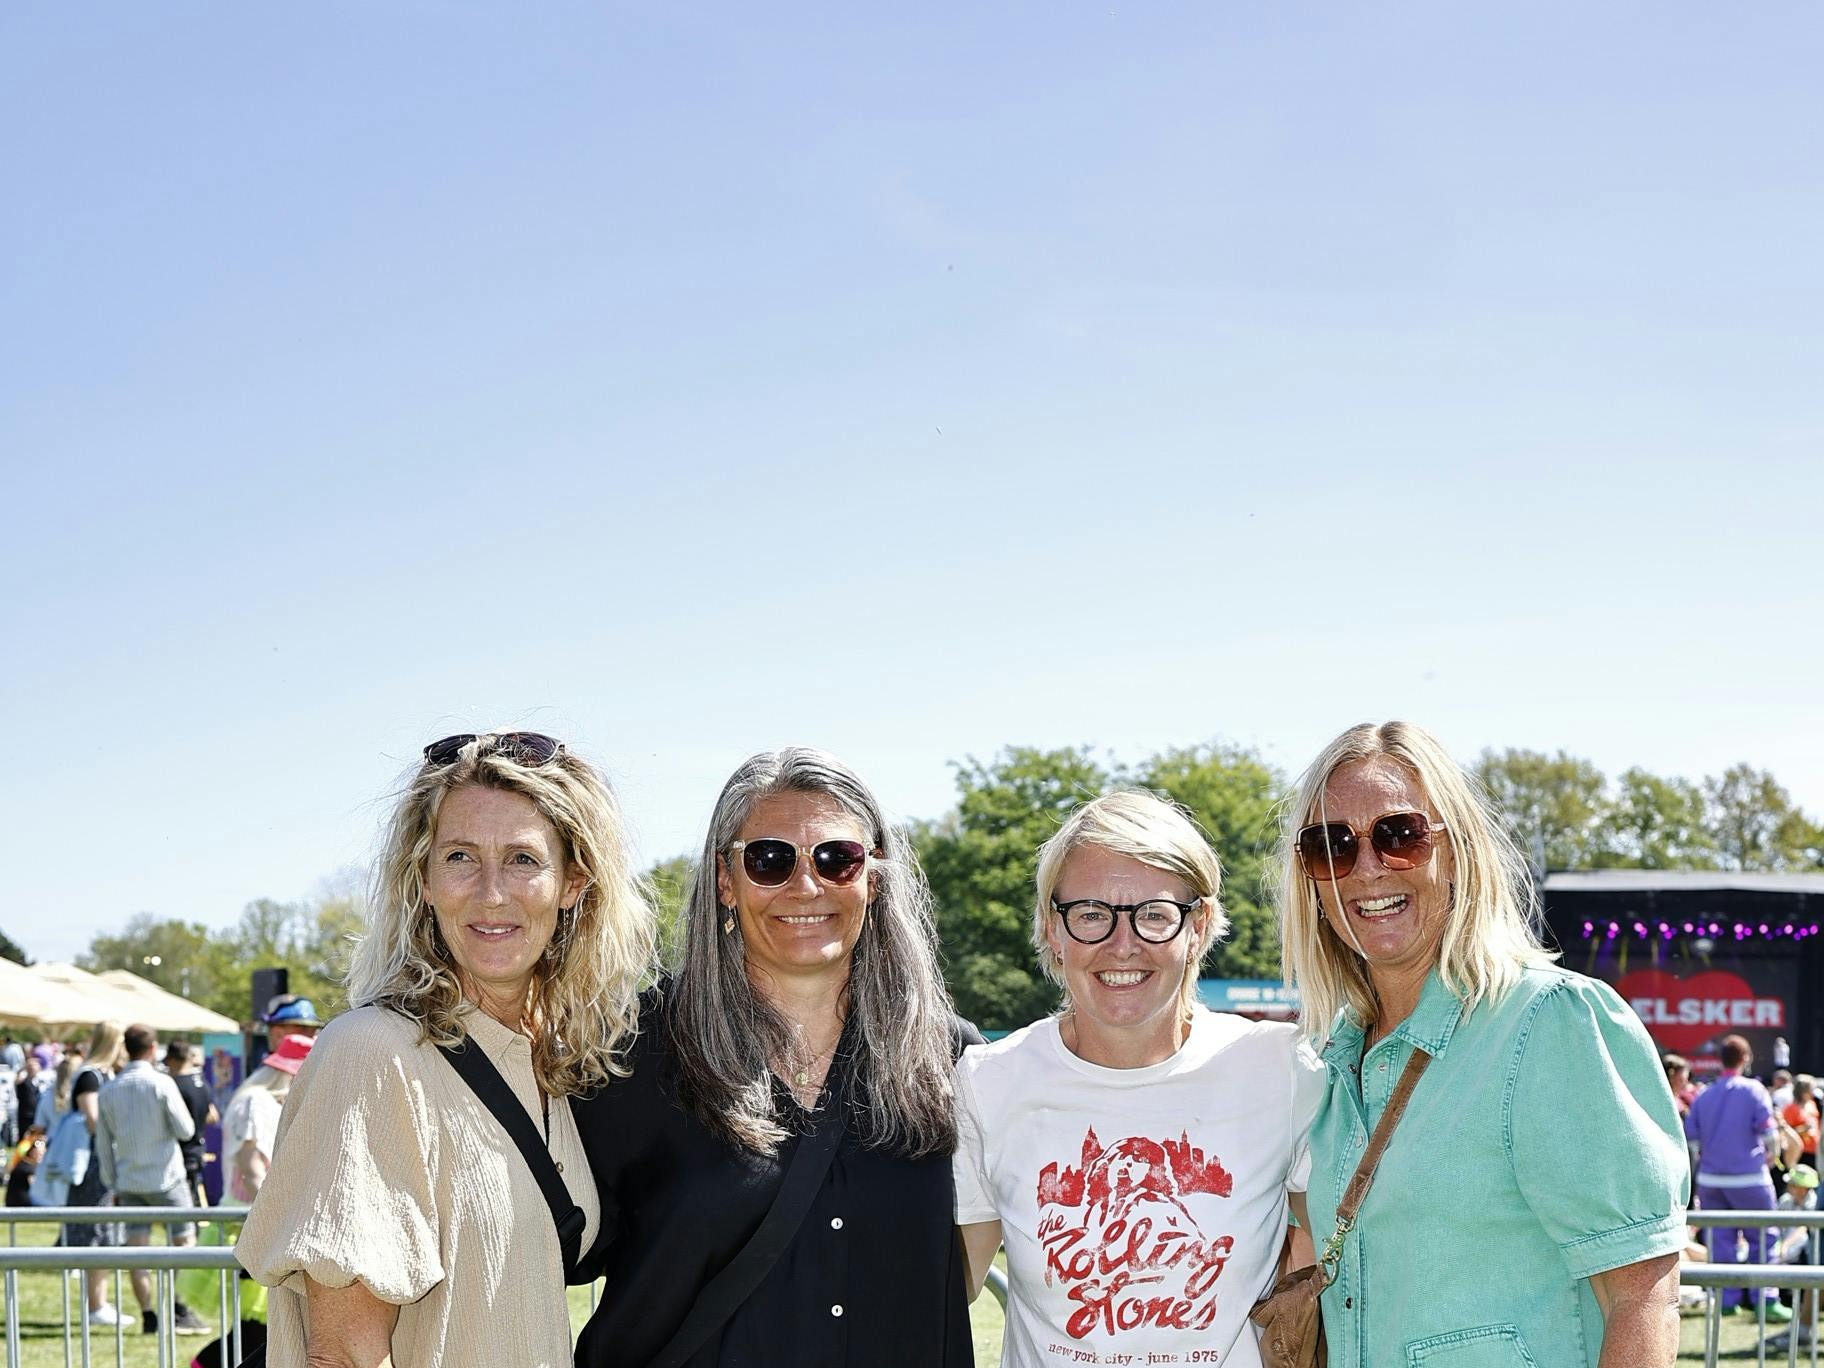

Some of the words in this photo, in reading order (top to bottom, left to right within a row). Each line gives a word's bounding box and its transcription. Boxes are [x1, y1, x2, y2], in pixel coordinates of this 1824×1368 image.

[1629, 997, 1781, 1026] ELSKER
[1037, 1209, 1068, 1240] the
[1042, 1217, 1235, 1301] Rolling
[1065, 1271, 1219, 1340] Stones
[1048, 1342, 1073, 1356] new
[1073, 1350, 1100, 1364] york
[1105, 1353, 1133, 1366] city
[1146, 1351, 1179, 1367] june
[1184, 1350, 1219, 1364] 1975
